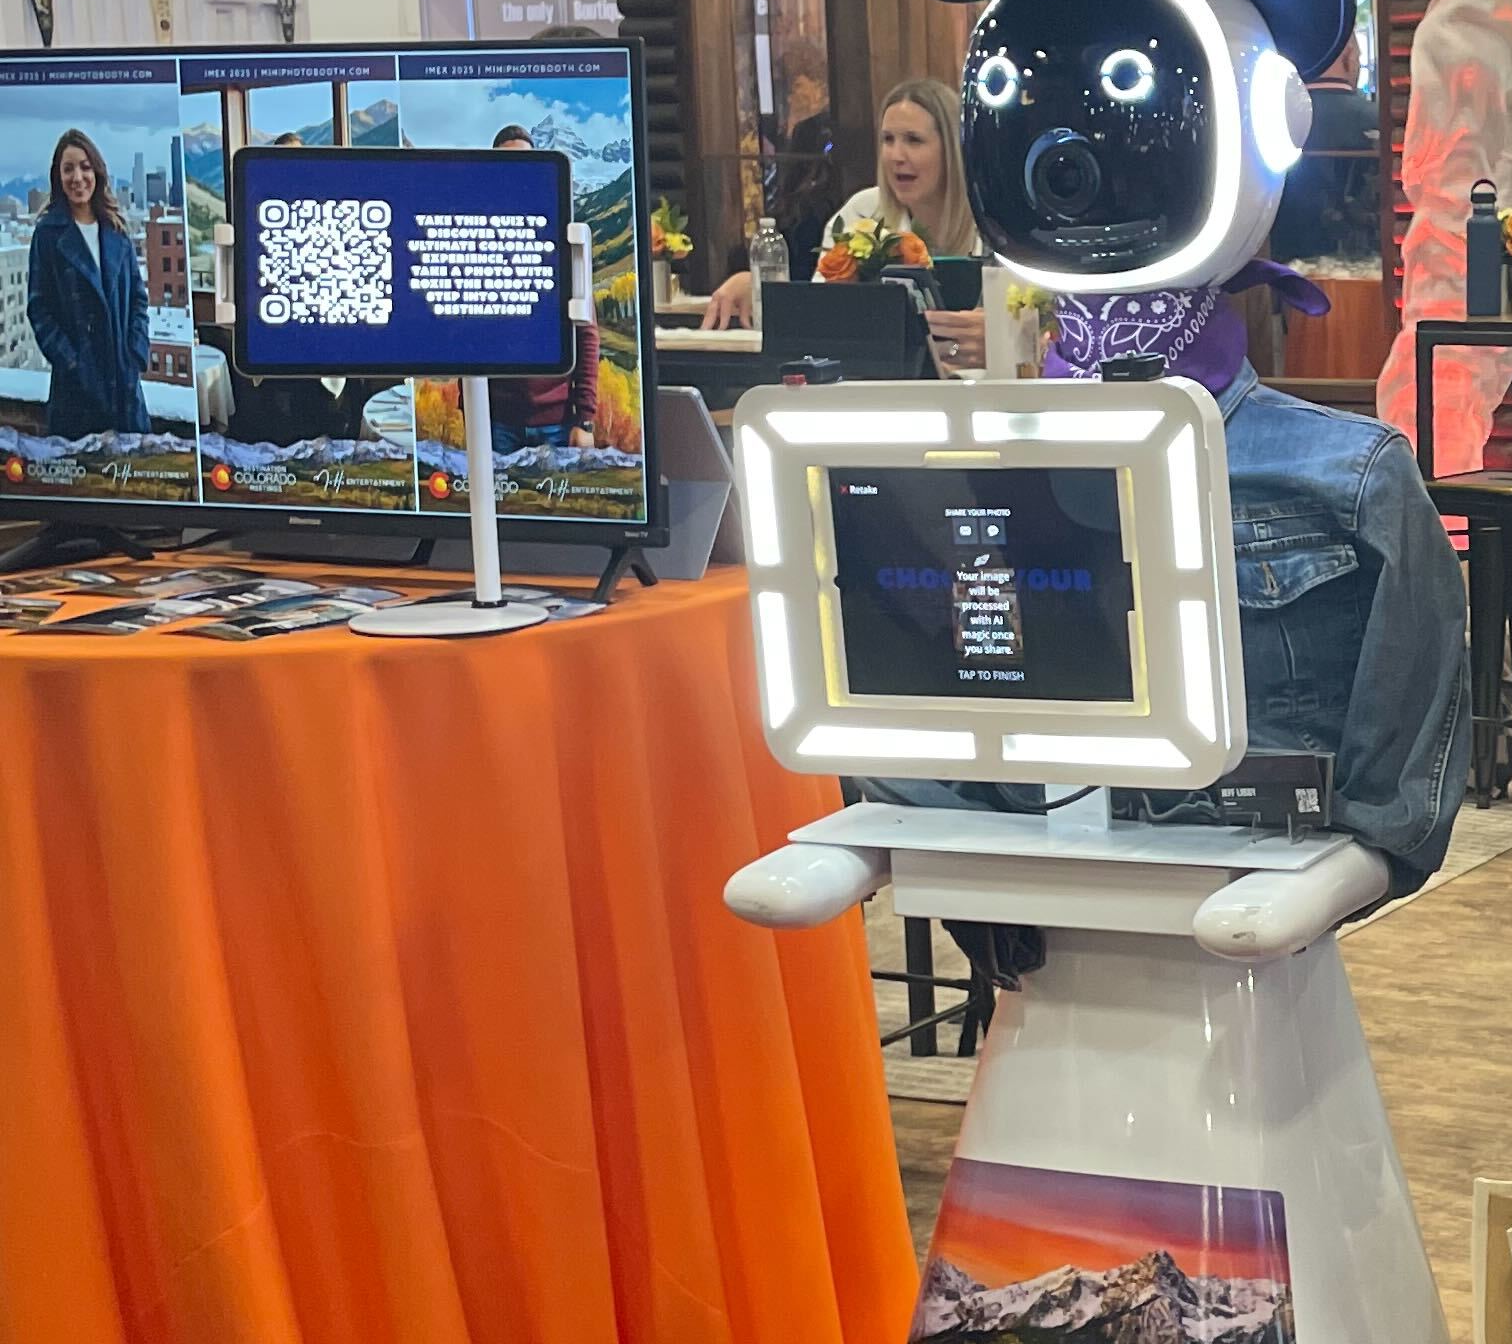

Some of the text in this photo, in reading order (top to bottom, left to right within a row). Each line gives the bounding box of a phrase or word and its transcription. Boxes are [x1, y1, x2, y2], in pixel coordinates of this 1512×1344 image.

[415, 214, 547, 227] TAKE THIS QUIZ TO
[427, 228, 536, 239] DISCOVER YOUR
[407, 240, 555, 252] ULTIMATE COLORADO
[511, 254, 542, 264] AND
[410, 265, 553, 277] TAKE A PHOTO WITH
[454, 278, 482, 289] THE
[483, 278, 532, 289] ROBOT
[533, 278, 554, 290] TO
[426, 291, 539, 302] STEP INTO YOUR
[27, 464, 87, 479] COLORADO
[233, 471, 297, 486] COLORADO
[452, 479, 519, 494] COADO
[849, 484, 878, 495] Retake
[987, 509, 1011, 517] PHOTO
[957, 570, 1009, 584] Your image
[968, 586, 1000, 596] will be
[962, 600, 1009, 612] processed
[970, 615, 1004, 625] with AI
[962, 629, 1015, 642] magic once
[964, 646, 983, 657] you
[958, 670, 1025, 681] TAP TO FINISH
